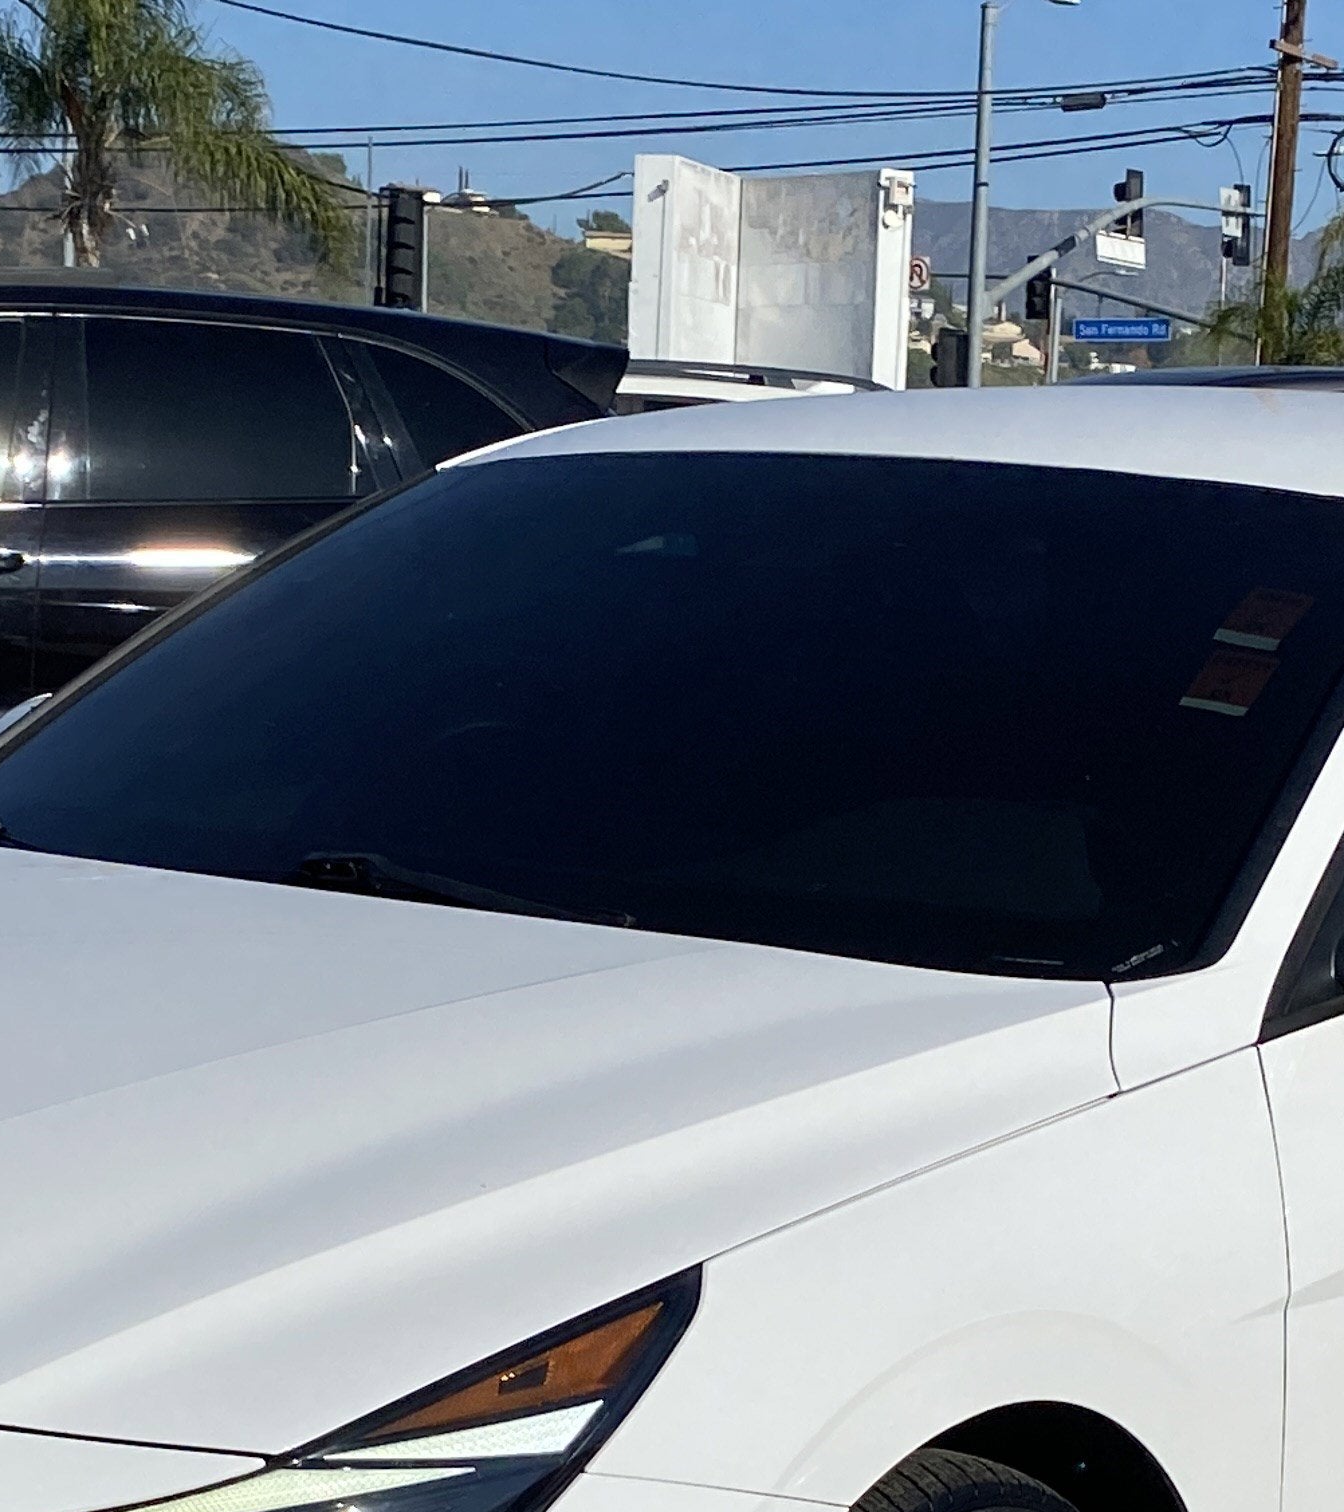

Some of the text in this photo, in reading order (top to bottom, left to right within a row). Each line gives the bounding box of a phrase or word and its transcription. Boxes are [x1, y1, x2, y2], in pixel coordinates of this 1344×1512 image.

[1079, 323, 1168, 336] San Fernando Rd
